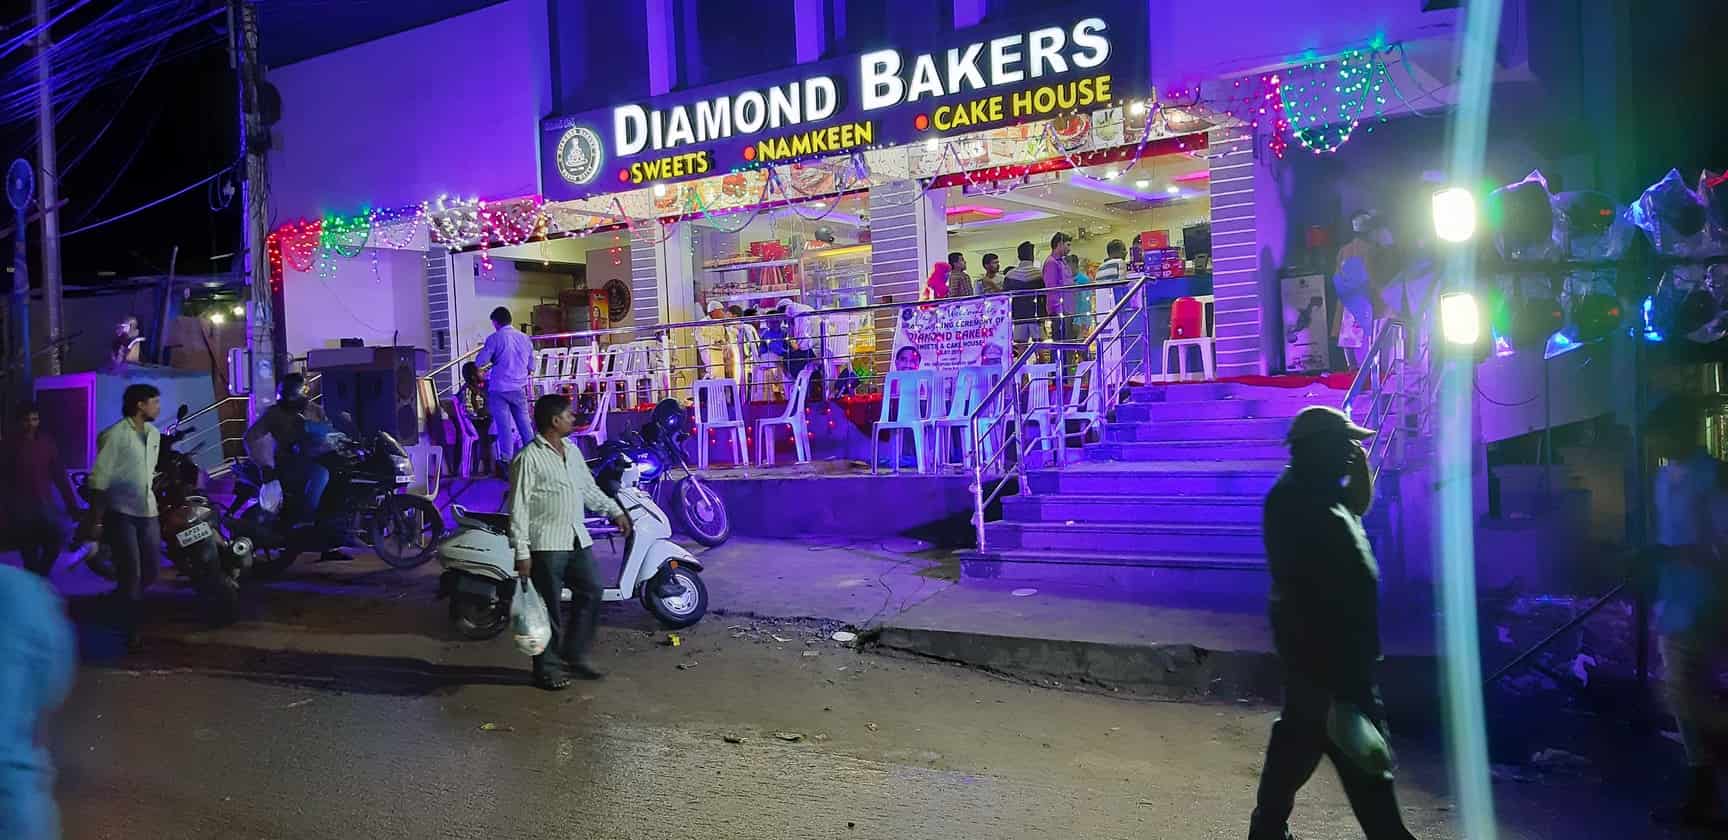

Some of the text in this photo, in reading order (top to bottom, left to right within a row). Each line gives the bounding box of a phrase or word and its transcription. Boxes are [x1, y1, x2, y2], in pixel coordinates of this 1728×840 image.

[614, 76, 837, 157] DIAMOND
[860, 18, 1110, 111] BAKERS
[630, 151, 709, 184] SWEETS
[757, 121, 873, 162] NAMKEEN
[933, 95, 1004, 132] CAKE
[1012, 75, 1113, 117] HOUSE
[907, 327, 994, 343] DIAMOND BAKERS
